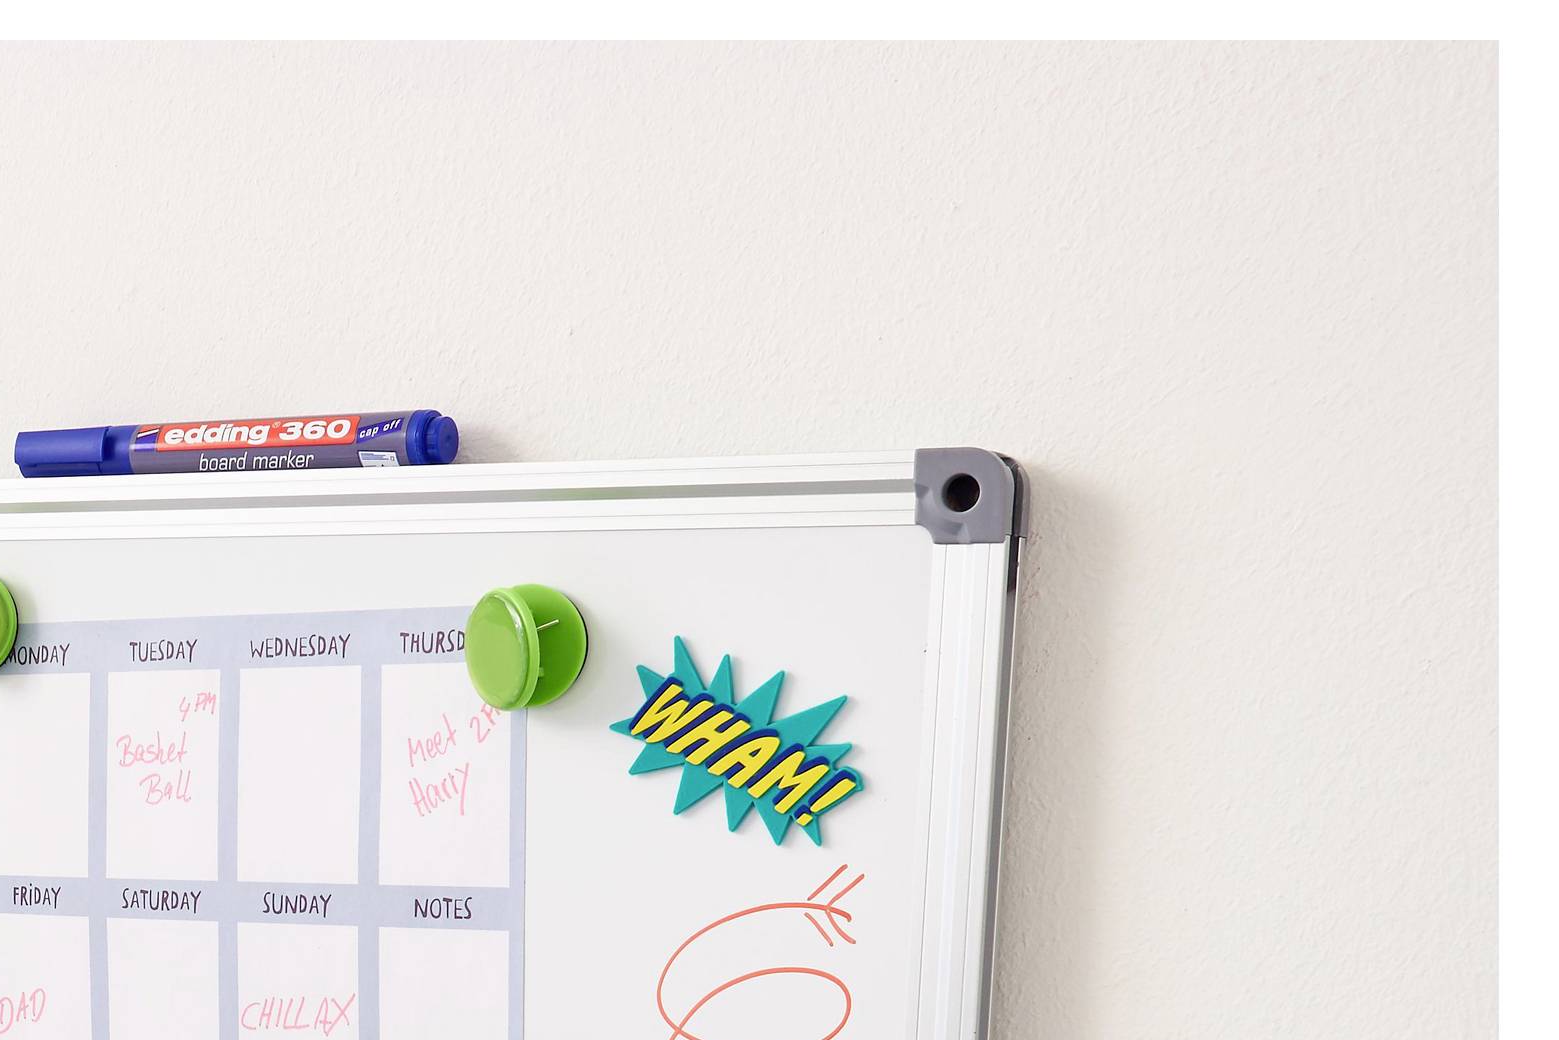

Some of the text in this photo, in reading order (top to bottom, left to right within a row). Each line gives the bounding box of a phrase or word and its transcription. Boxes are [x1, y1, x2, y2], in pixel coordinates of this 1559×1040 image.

[278, 418, 351, 440] 360
[359, 418, 401, 439] cap off
[199, 449, 315, 472] board marker
[129, 639, 198, 663] TUESDAY
[250, 633, 351, 659] WEDNESDAY
[399, 630, 465, 654] THURSD
[179, 692, 217, 722] 4 PM
[407, 713, 457, 767] Meet
[629, 676, 857, 827] WHAM!
[139, 770, 192, 805] Ball
[408, 762, 470, 817] Harry
[121, 888, 202, 914] SATURDAY
[262, 892, 332, 918] SUNDAY
[413, 897, 473, 920] NOTES
[240, 993, 356, 1037] CHILLAX
